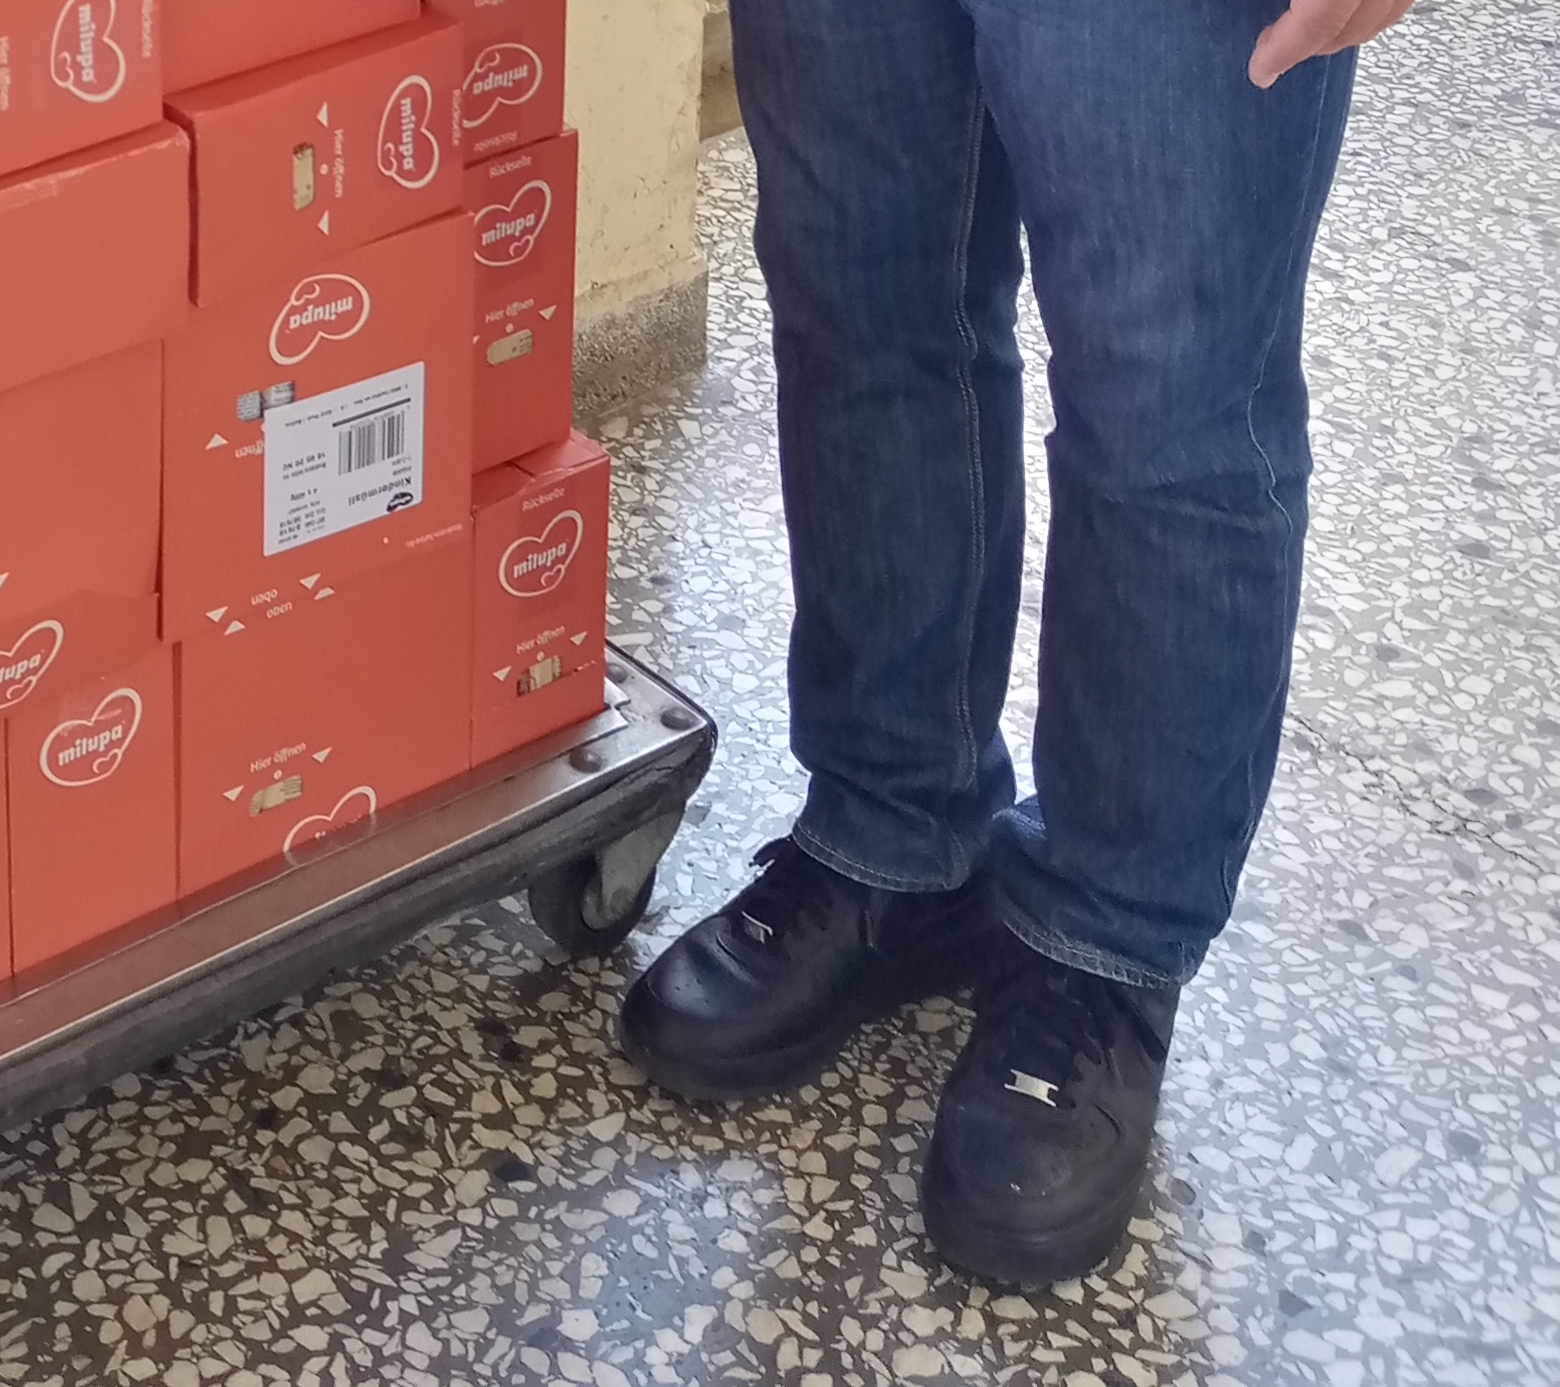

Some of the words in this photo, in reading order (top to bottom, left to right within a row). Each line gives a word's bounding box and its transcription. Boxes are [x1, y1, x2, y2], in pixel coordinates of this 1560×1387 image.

[76, 3, 96, 82] milupa
[473, 64, 528, 95] milupa
[334, 129, 344, 155] Hier
[399, 97, 416, 170] milupa
[333, 158, 345, 198] öffnen
[489, 155, 532, 178] Rückseite
[481, 213, 536, 246] milupa
[289, 296, 353, 329] milupa
[485, 309, 504, 324] Hier
[505, 298, 534, 317] öffnen
[348, 476, 412, 506] Kindermüsli
[522, 488, 565, 512] Rückseite
[513, 542, 567, 578] milupa
[251, 588, 278, 605] oben
[516, 638, 535, 654] Hier
[536, 625, 566, 646] öffnen
[58, 724, 123, 766] milupa
[250, 756, 272, 773] Hier
[273, 742, 307, 763] öffnen
